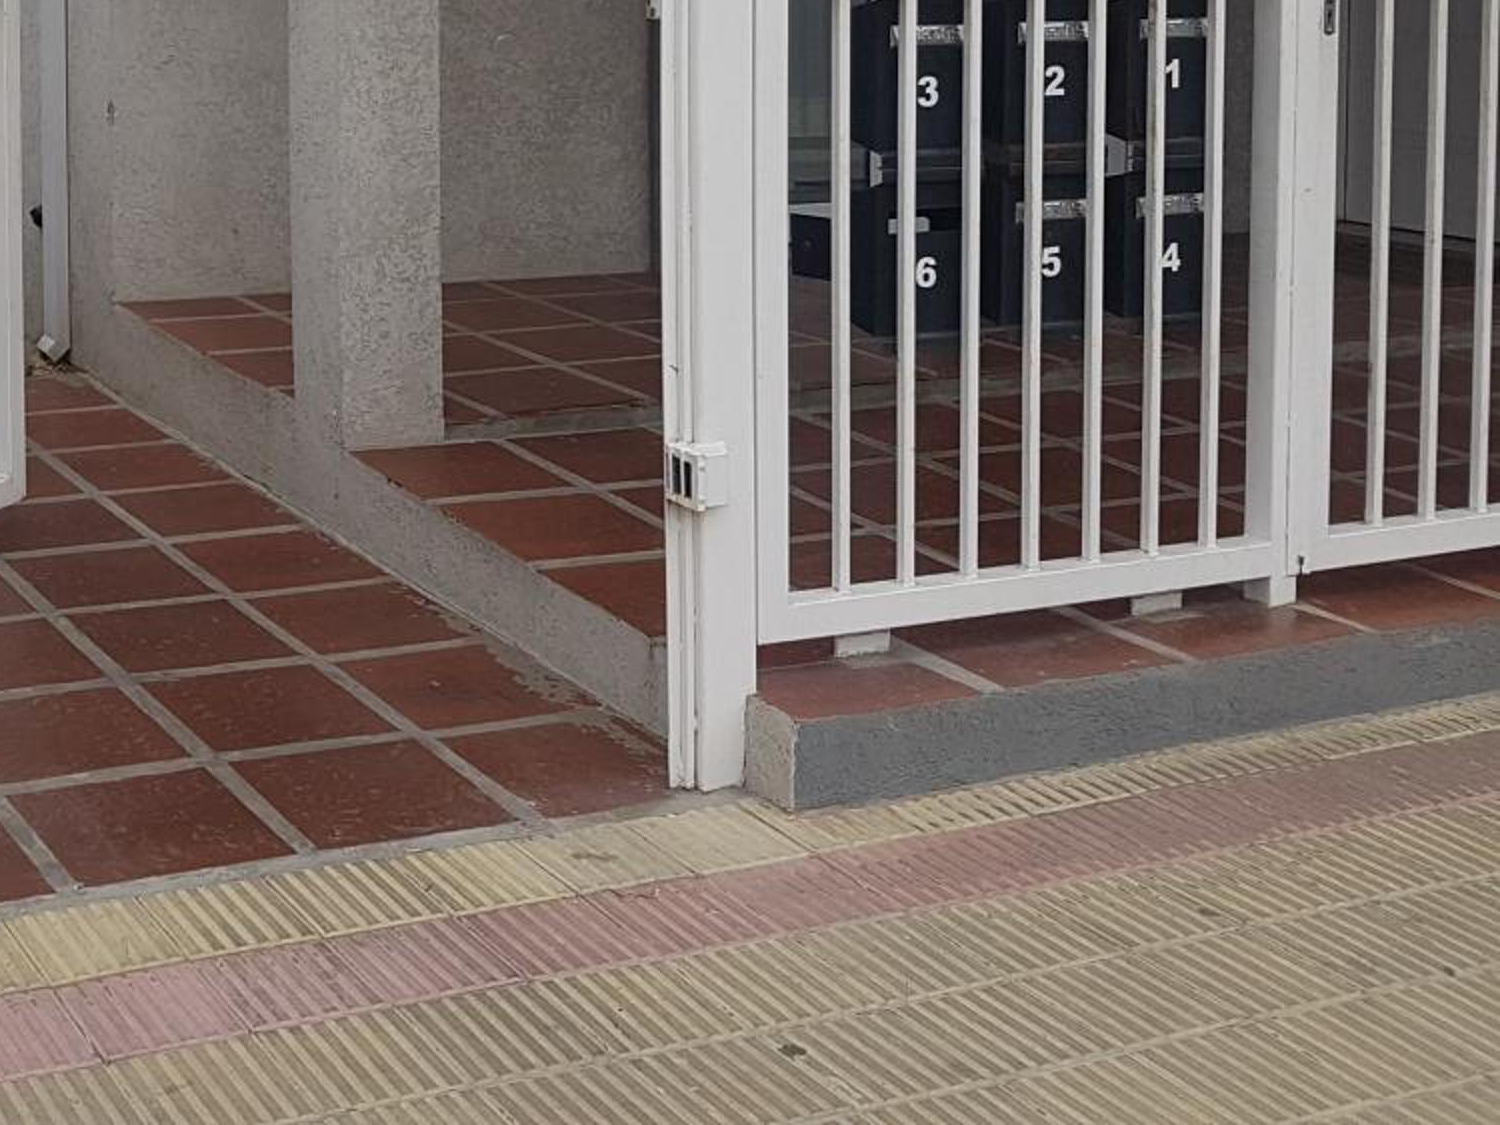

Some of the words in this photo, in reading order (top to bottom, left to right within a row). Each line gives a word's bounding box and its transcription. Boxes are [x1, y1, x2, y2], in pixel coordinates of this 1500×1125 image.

[1044, 65, 1066, 97] 2
[1165, 58, 1180, 89] 1
[917, 75, 940, 108] 3
[914, 256, 937, 288] 6
[1041, 245, 1062, 277] 5
[1160, 242, 1181, 272] 4
